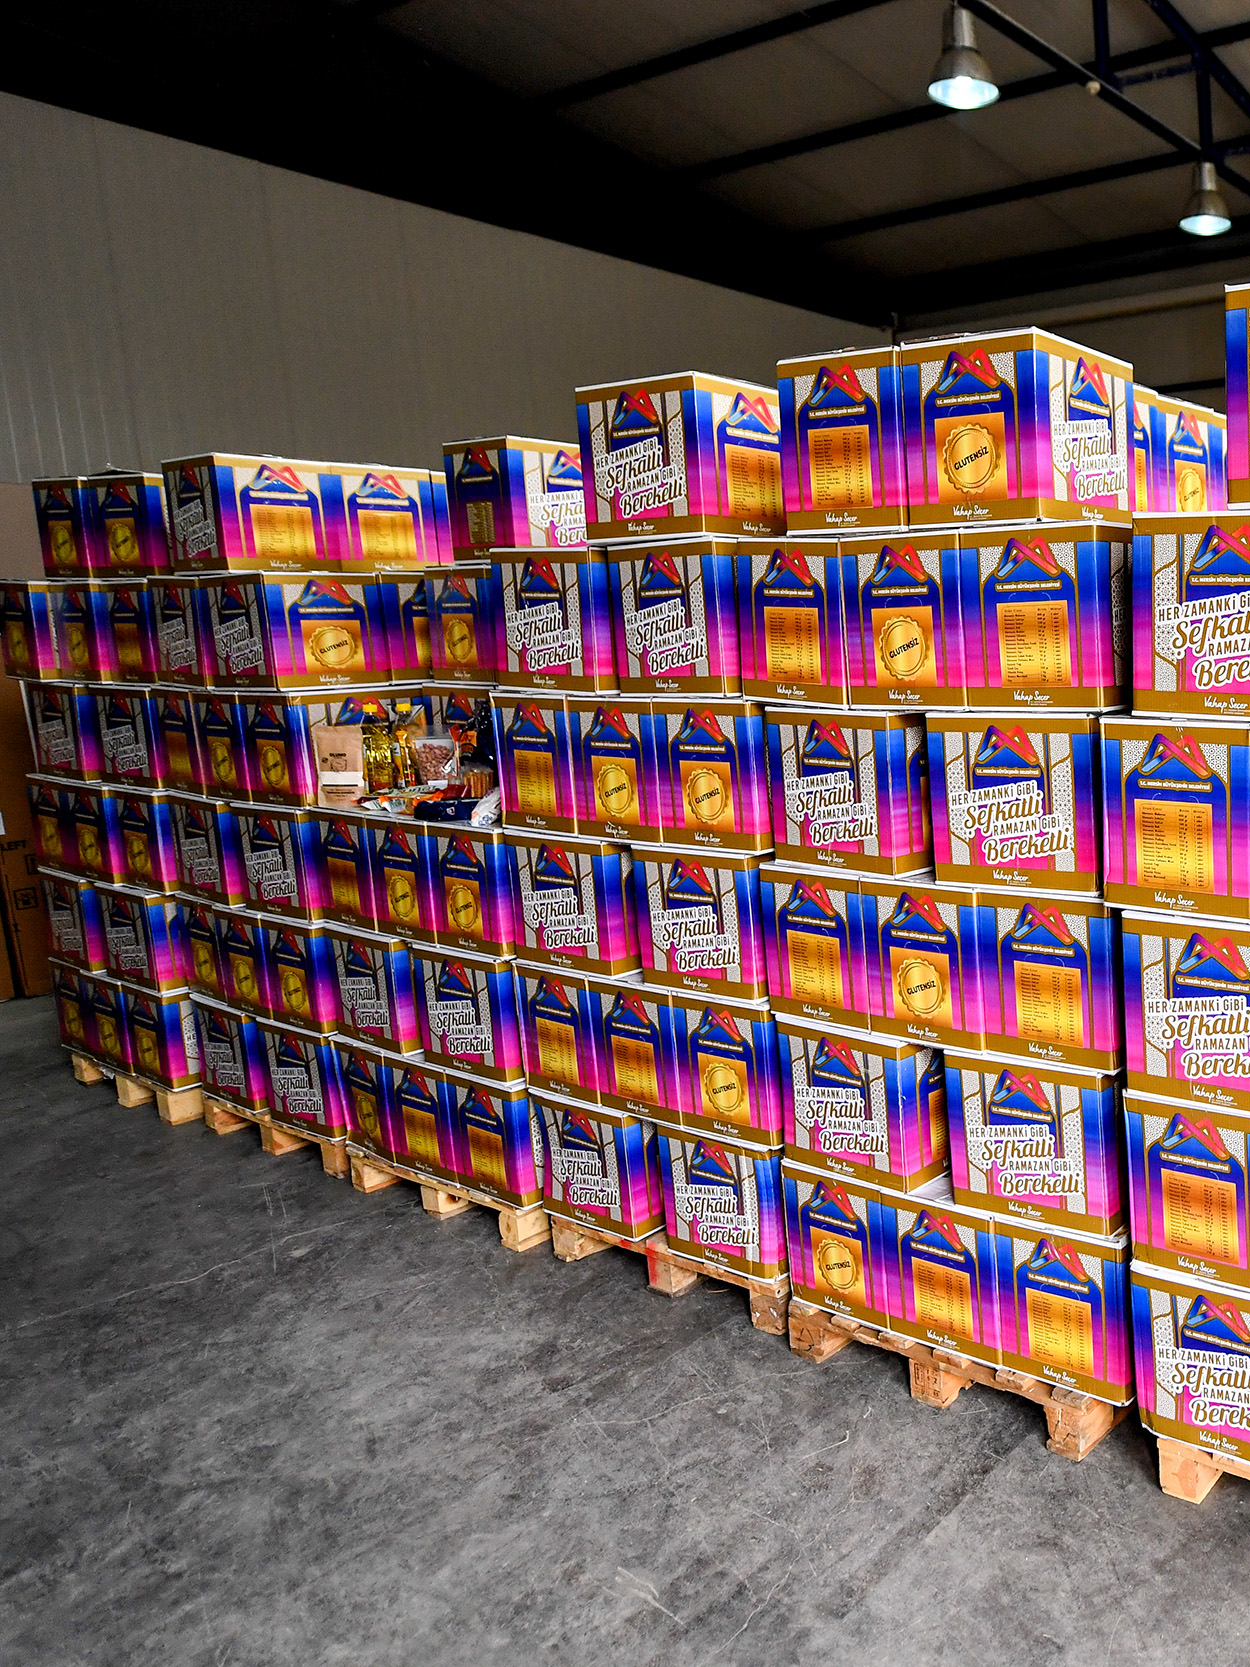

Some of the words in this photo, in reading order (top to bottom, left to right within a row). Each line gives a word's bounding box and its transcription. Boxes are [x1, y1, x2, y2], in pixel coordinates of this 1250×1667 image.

[953, 446, 988, 470] GLUTENSİZ
[889, 637, 919, 658] GLUTENSİZ
[605, 782, 627, 798] GLUTENSİZ
[695, 787, 720, 804] GLUTENSİZ
[952, 793, 969, 806] HER
[994, 819, 1038, 836] RAMAZAN
[983, 828, 1070, 862] Bereketli
[906, 979, 936, 995] GLUTENSİZ
[712, 1082, 736, 1095] GLUTENSİZ
[970, 1127, 986, 1138] HER
[1009, 1160, 1051, 1172] RAMAZAN
[1000, 1173, 1081, 1194] Bereketli
[825, 1259, 851, 1271] GLUTENSİZ
